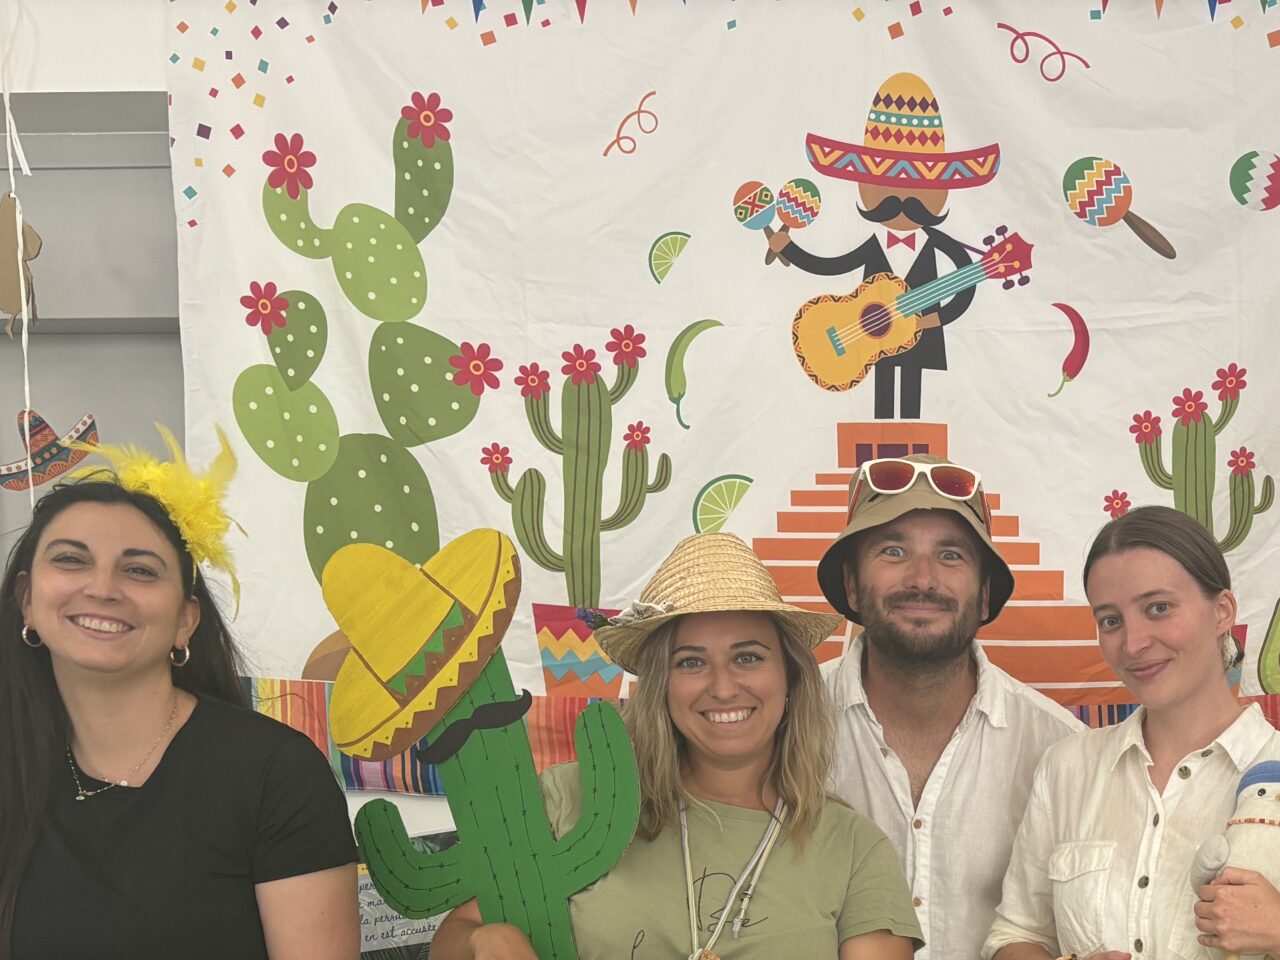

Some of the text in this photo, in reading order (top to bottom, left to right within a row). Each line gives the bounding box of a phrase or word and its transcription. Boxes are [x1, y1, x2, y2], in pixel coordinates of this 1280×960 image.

[359, 883, 376, 893] per
[367, 899, 384, 907] ma
[381, 926, 397, 940] est
